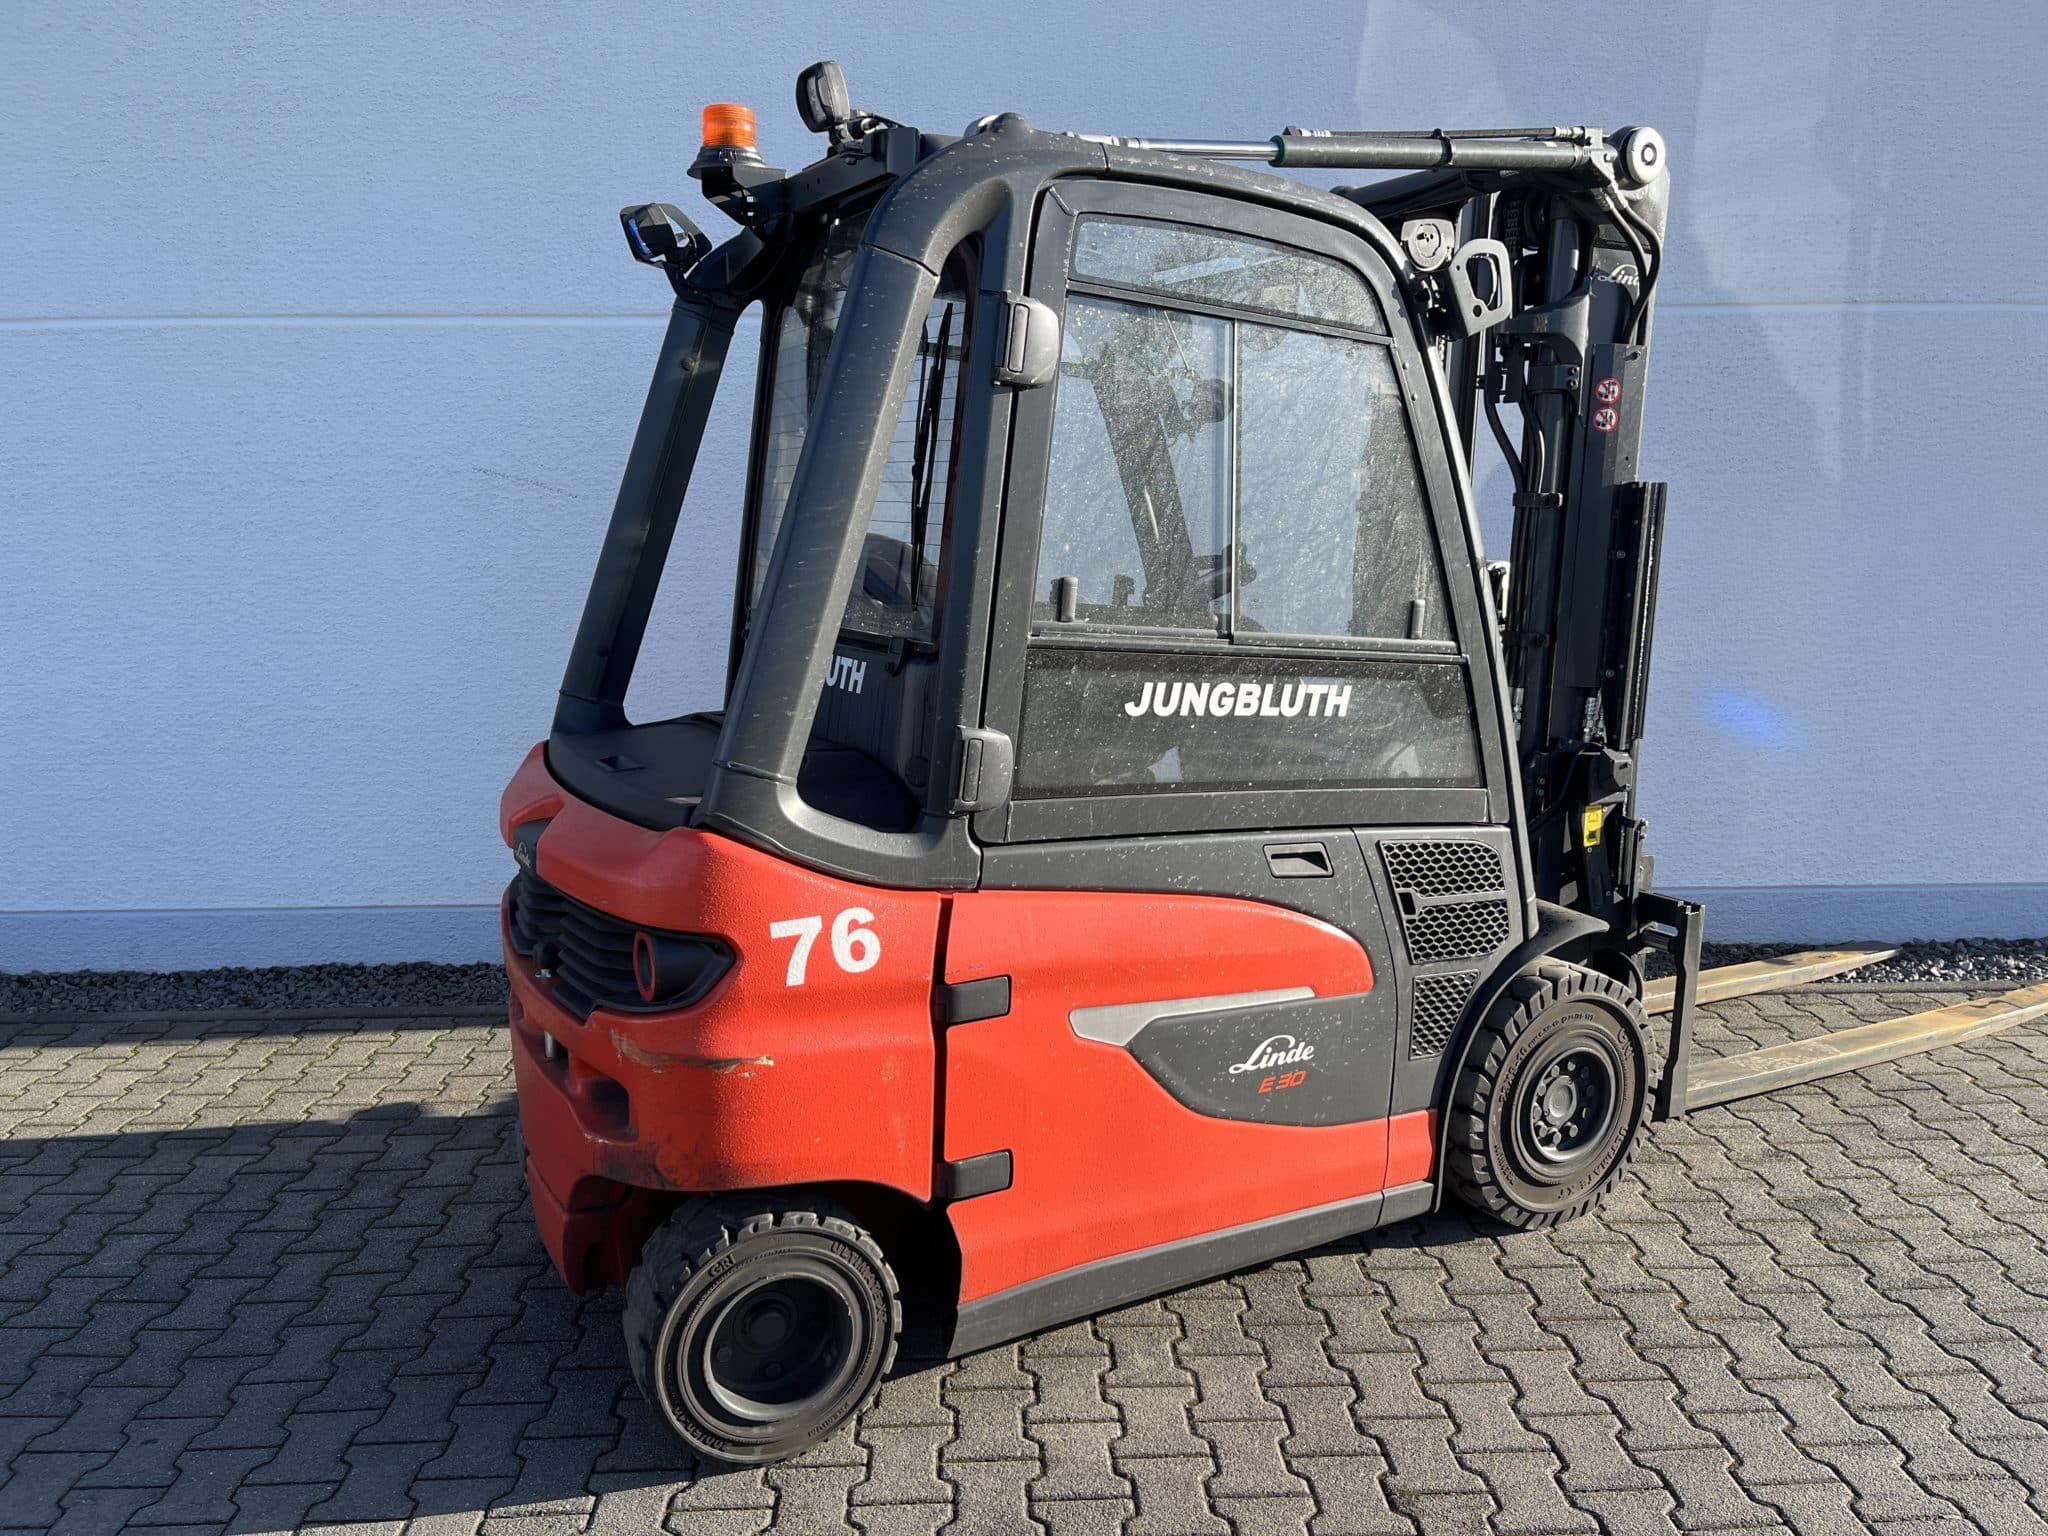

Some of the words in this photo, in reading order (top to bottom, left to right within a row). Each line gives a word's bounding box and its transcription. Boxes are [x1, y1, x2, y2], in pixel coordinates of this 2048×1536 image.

[1598, 264, 1640, 286] Lin
[1124, 681, 1352, 718] JUNGBLUTH
[769, 906, 881, 988] 76
[1228, 1034, 1315, 1075] Linde
[1258, 1075, 1277, 1095] E
[1275, 1069, 1308, 1091] 30
[707, 1253, 737, 1279] GRI
